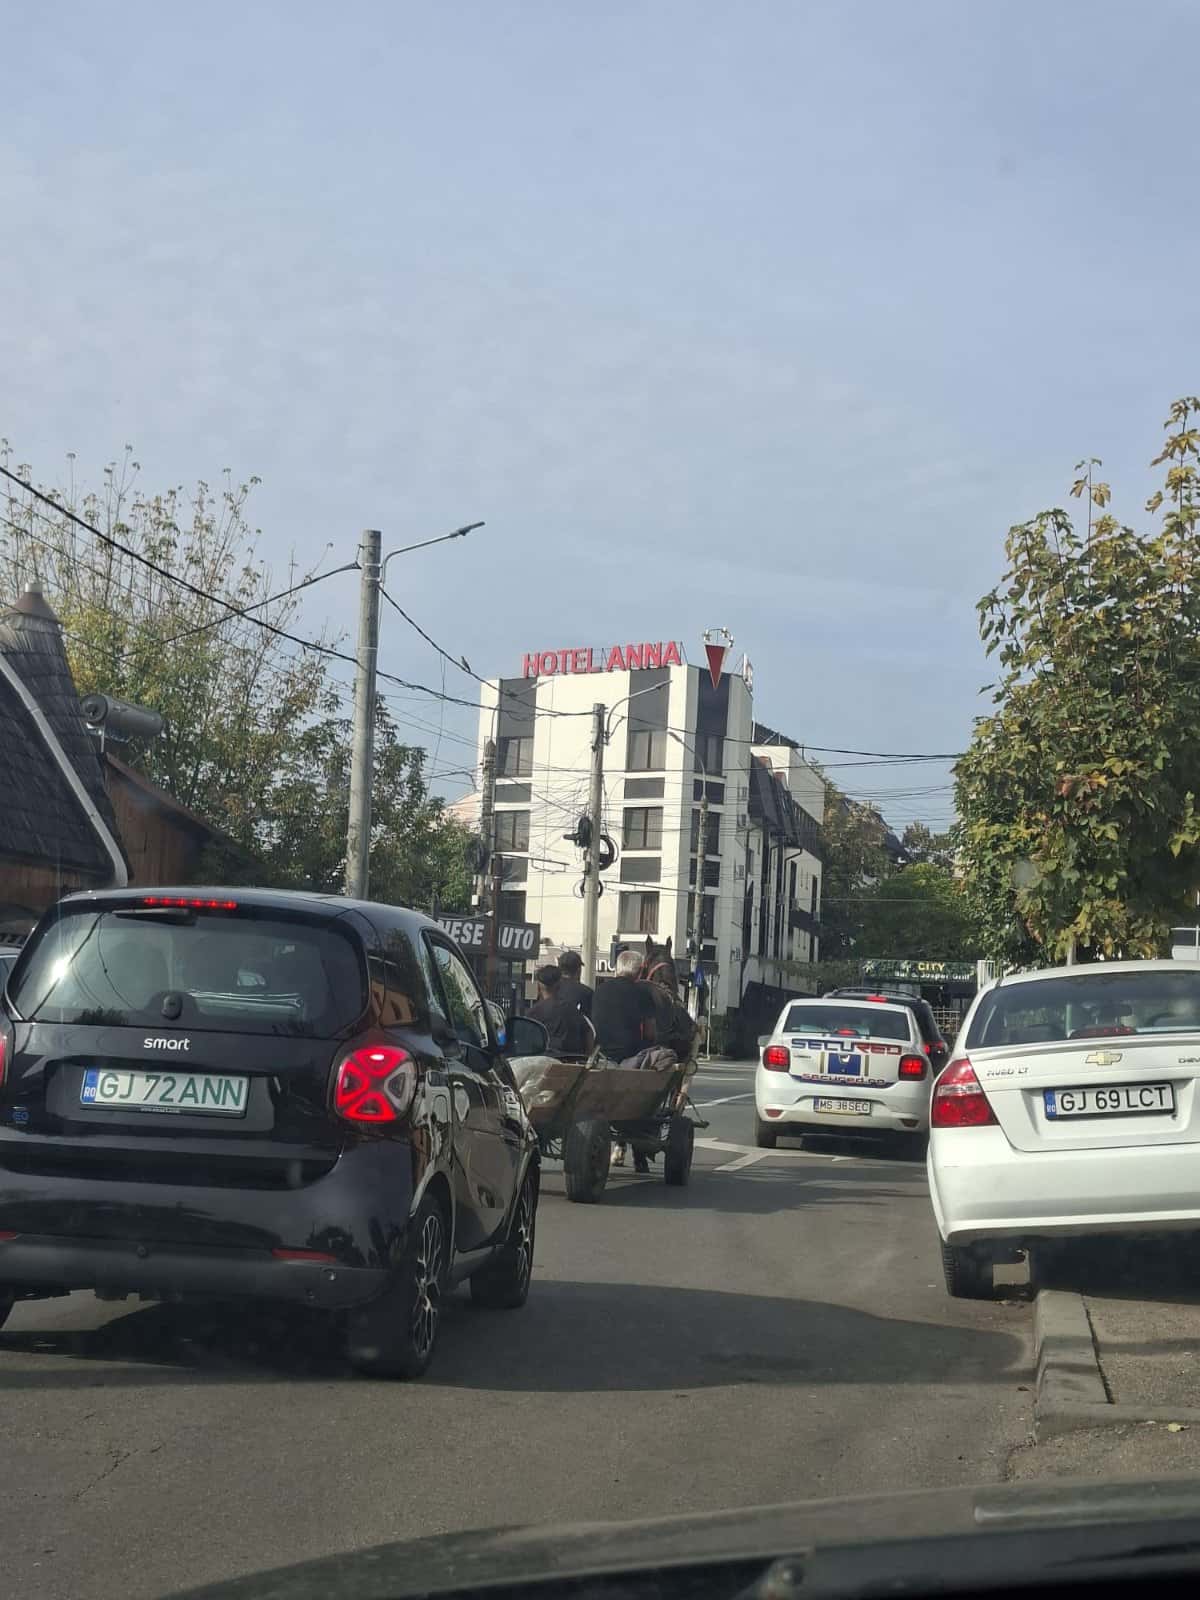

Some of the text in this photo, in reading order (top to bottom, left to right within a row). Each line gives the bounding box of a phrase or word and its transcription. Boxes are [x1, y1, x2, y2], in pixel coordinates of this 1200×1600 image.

[523, 641, 682, 678] HOTEL ANNA
[437, 919, 535, 950] IESE UTO
[918, 962, 945, 971] CITY
[143, 1037, 190, 1051] smart
[791, 1038, 902, 1056] SECURED
[83, 1085, 97, 1098] RO
[99, 1072, 135, 1099] GJ
[820, 1101, 833, 1110] MS
[1060, 1086, 1167, 1112] GJ 69 LCT
